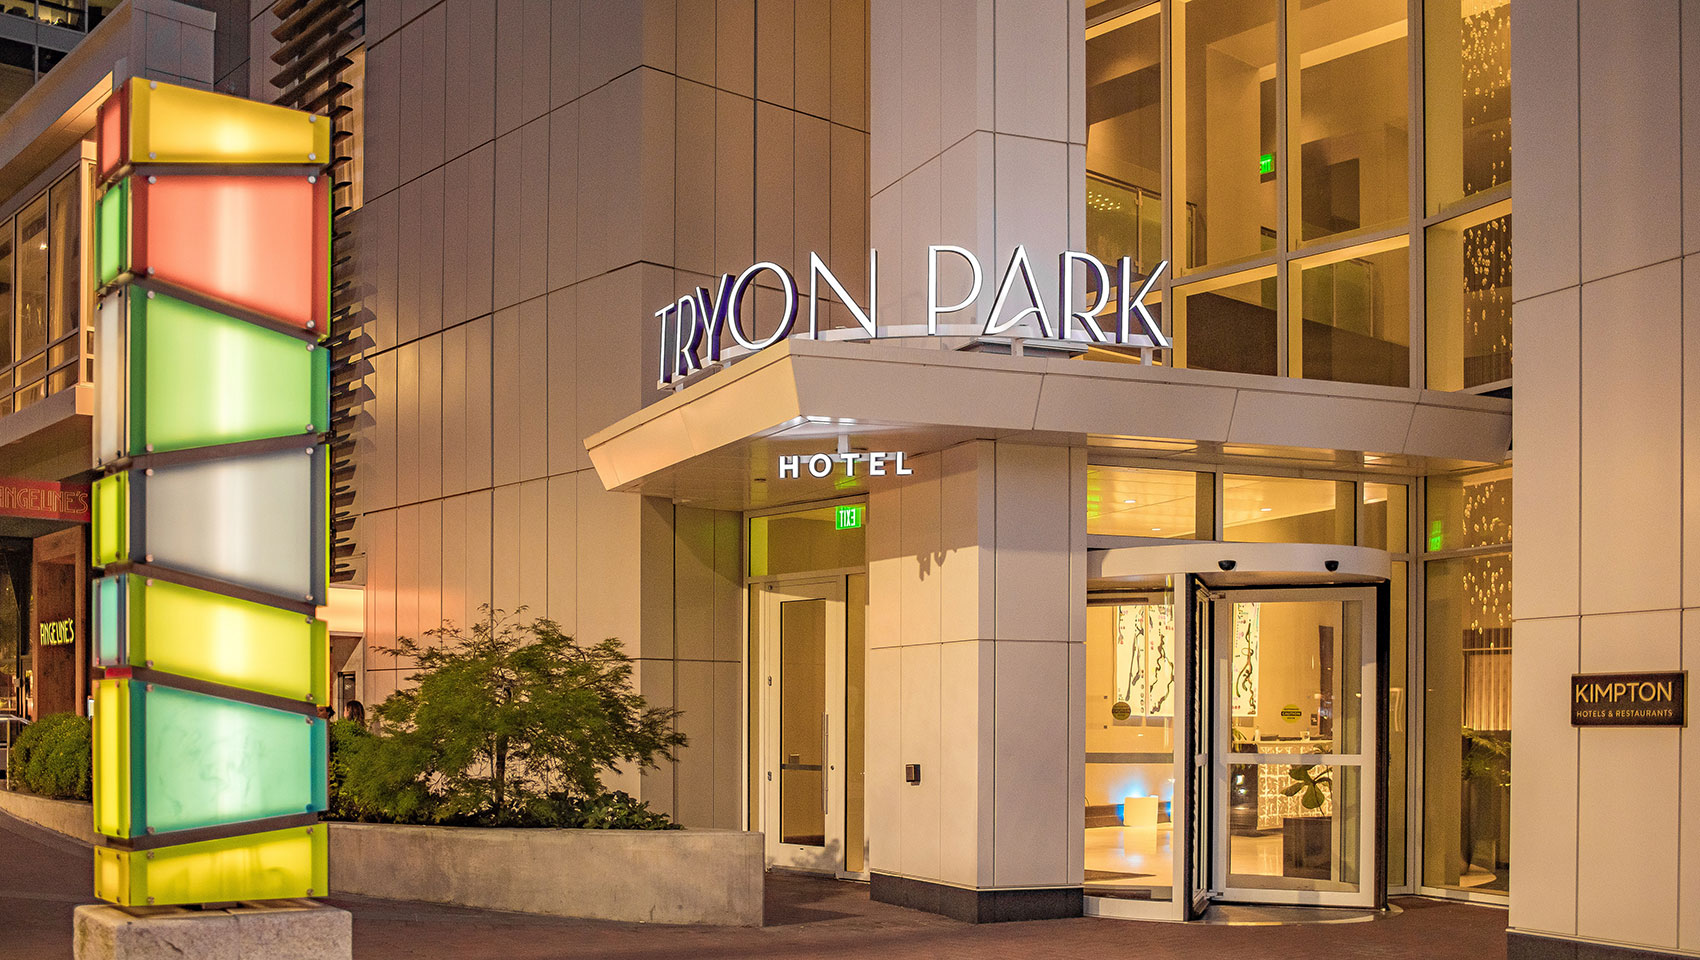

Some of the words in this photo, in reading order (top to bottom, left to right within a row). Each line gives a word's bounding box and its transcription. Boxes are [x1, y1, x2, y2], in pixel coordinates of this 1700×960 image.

[655, 248, 878, 384] TRYON
[927, 244, 1169, 347] PARK
[778, 451, 914, 479] HOTEL
[40, 618, 74, 646] ANGELINE'S
[1576, 682, 1672, 703] KIMPTON
[1577, 710, 1606, 718] HOTELS
[1608, 710, 1614, 718] &
[1616, 709, 1673, 717] RESTAURANTS
